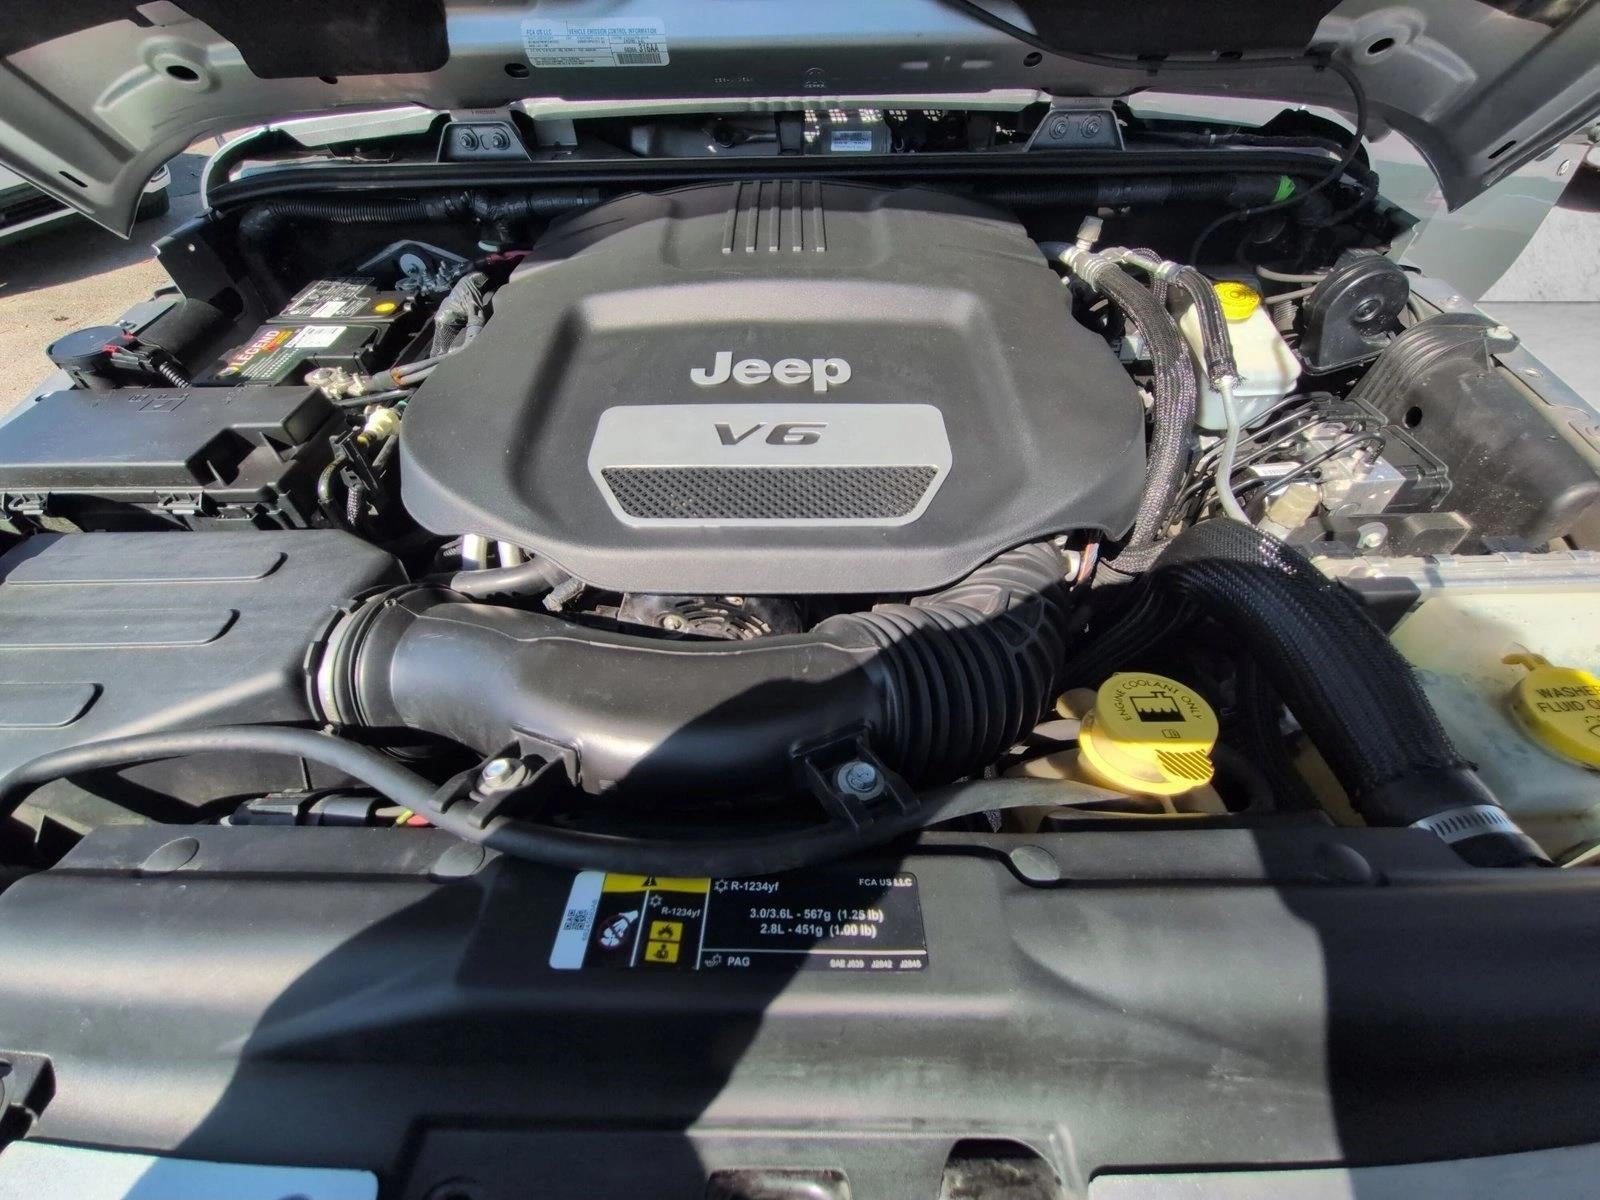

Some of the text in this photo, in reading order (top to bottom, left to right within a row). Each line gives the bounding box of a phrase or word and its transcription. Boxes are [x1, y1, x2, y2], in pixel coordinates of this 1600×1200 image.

[229, 330, 281, 366] LEGEND
[690, 351, 852, 393] Jeep
[714, 421, 829, 446] V6
[1113, 679, 1202, 721] ENGINE COOLANT ONLY
[1536, 701, 1585, 713] FLUID
[729, 880, 780, 894] R-1234yf
[859, 878, 878, 887] FCA
[880, 878, 892, 887] US
[661, 906, 701, 918] R-1234yf
[749, 907, 793, 919] 3.0/3.6L
[804, 908, 831, 921] 567g
[837, 909, 866, 922] (1.25
[867, 908, 884, 923] lb)
[760, 923, 785, 935] 2.8L
[795, 924, 823, 938] 451g
[830, 924, 858, 938] (1.00
[860, 924, 877, 939] lb)
[727, 956, 750, 968] PAG
